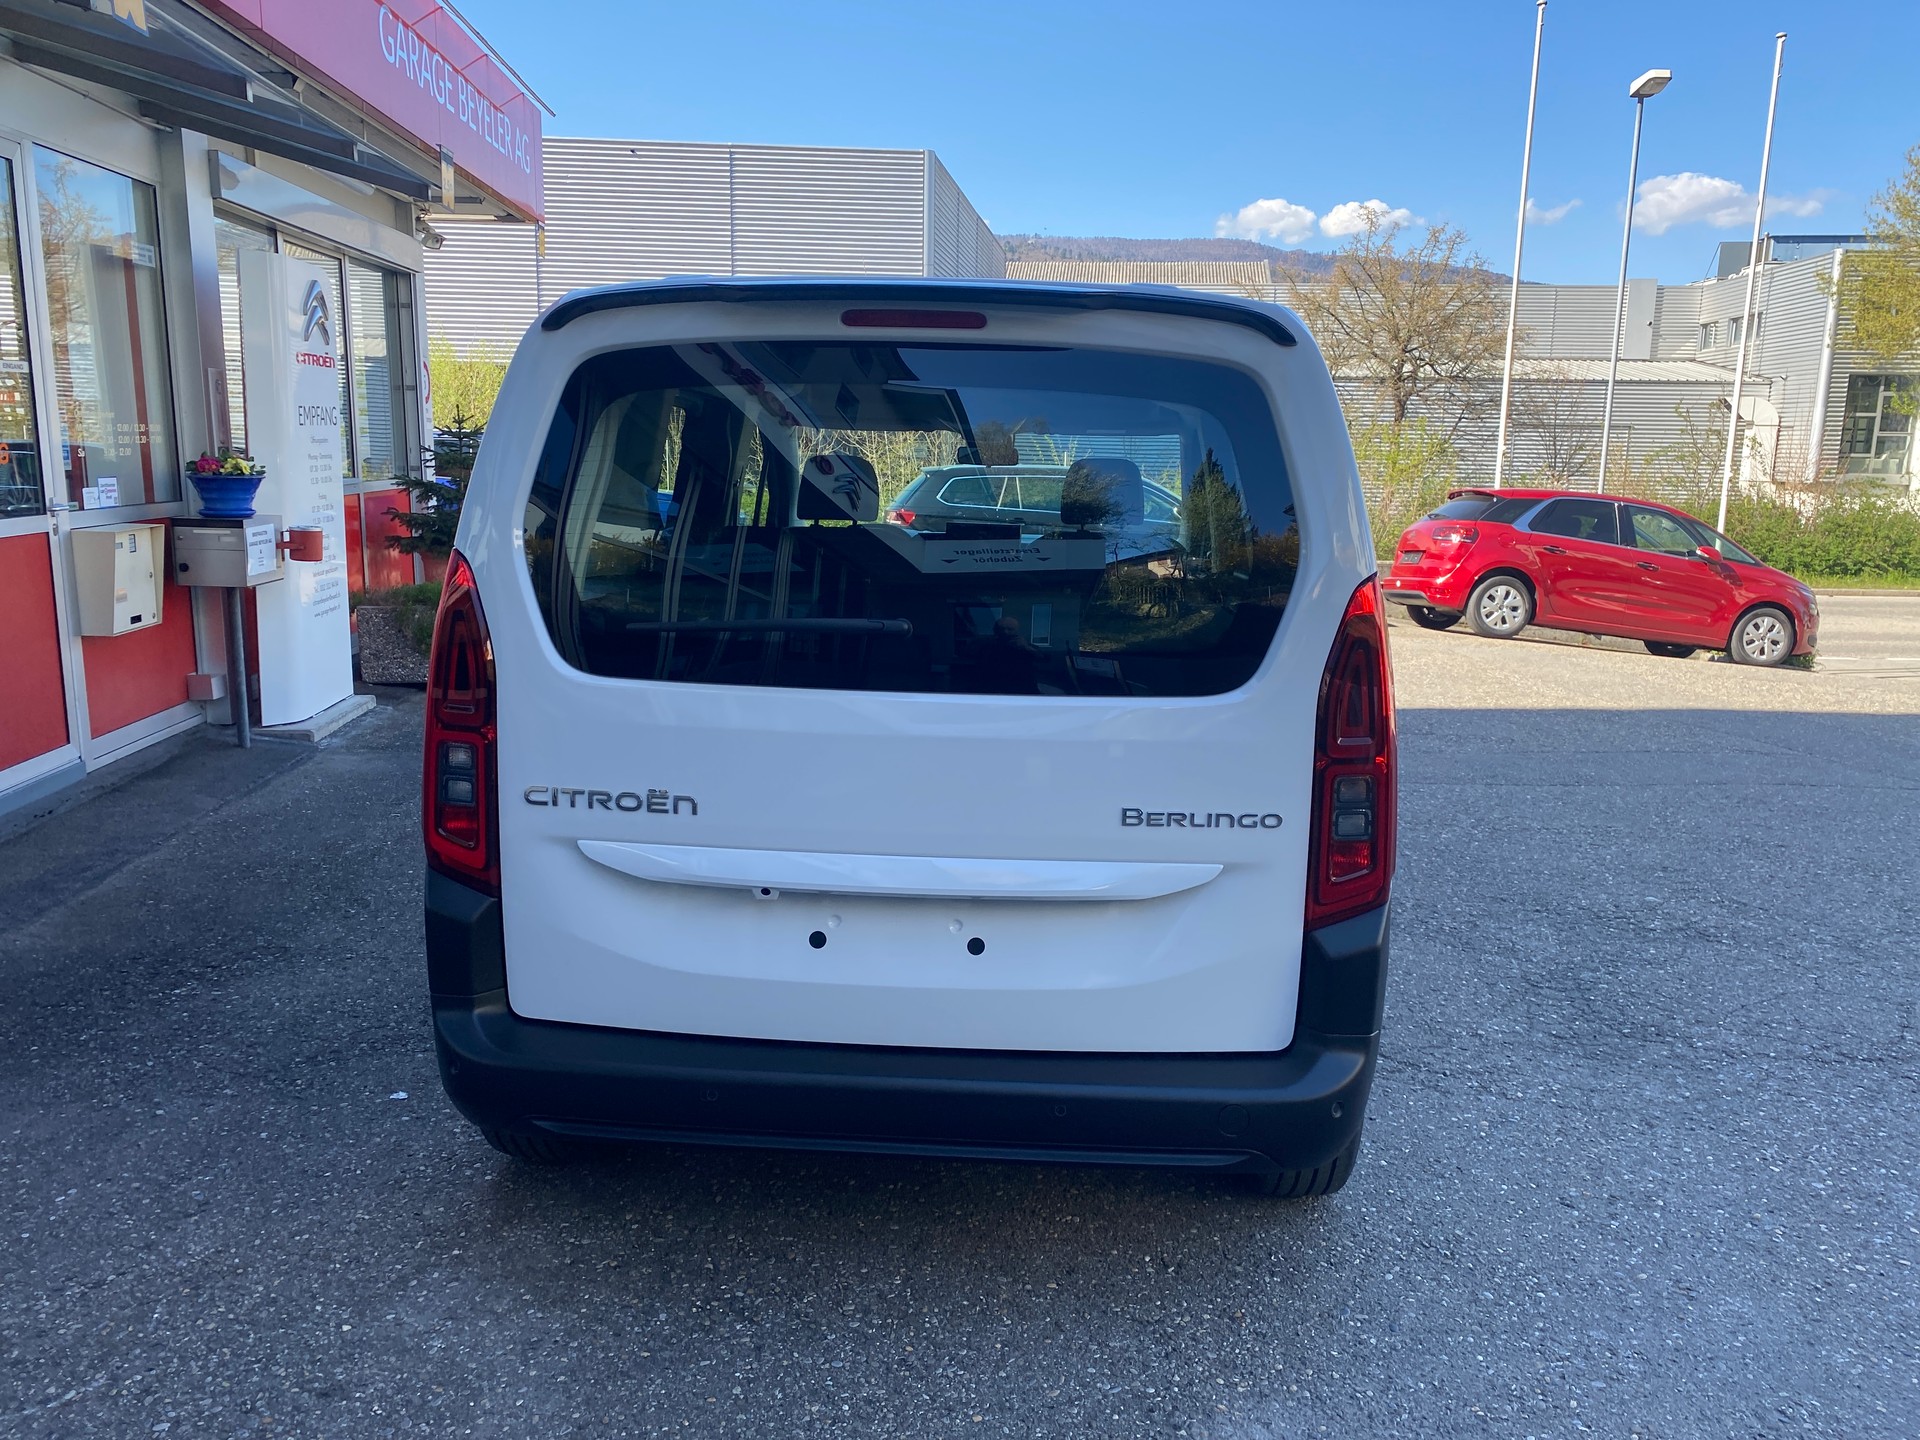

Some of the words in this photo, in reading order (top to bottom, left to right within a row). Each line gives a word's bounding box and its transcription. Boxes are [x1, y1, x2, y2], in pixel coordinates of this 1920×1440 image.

[379, 4, 455, 114] GARAGE
[457, 75, 513, 161] BEYELER
[515, 127, 531, 174] AG
[2, 362, 24, 370] EINGANG
[298, 405, 338, 426] EMPFANG
